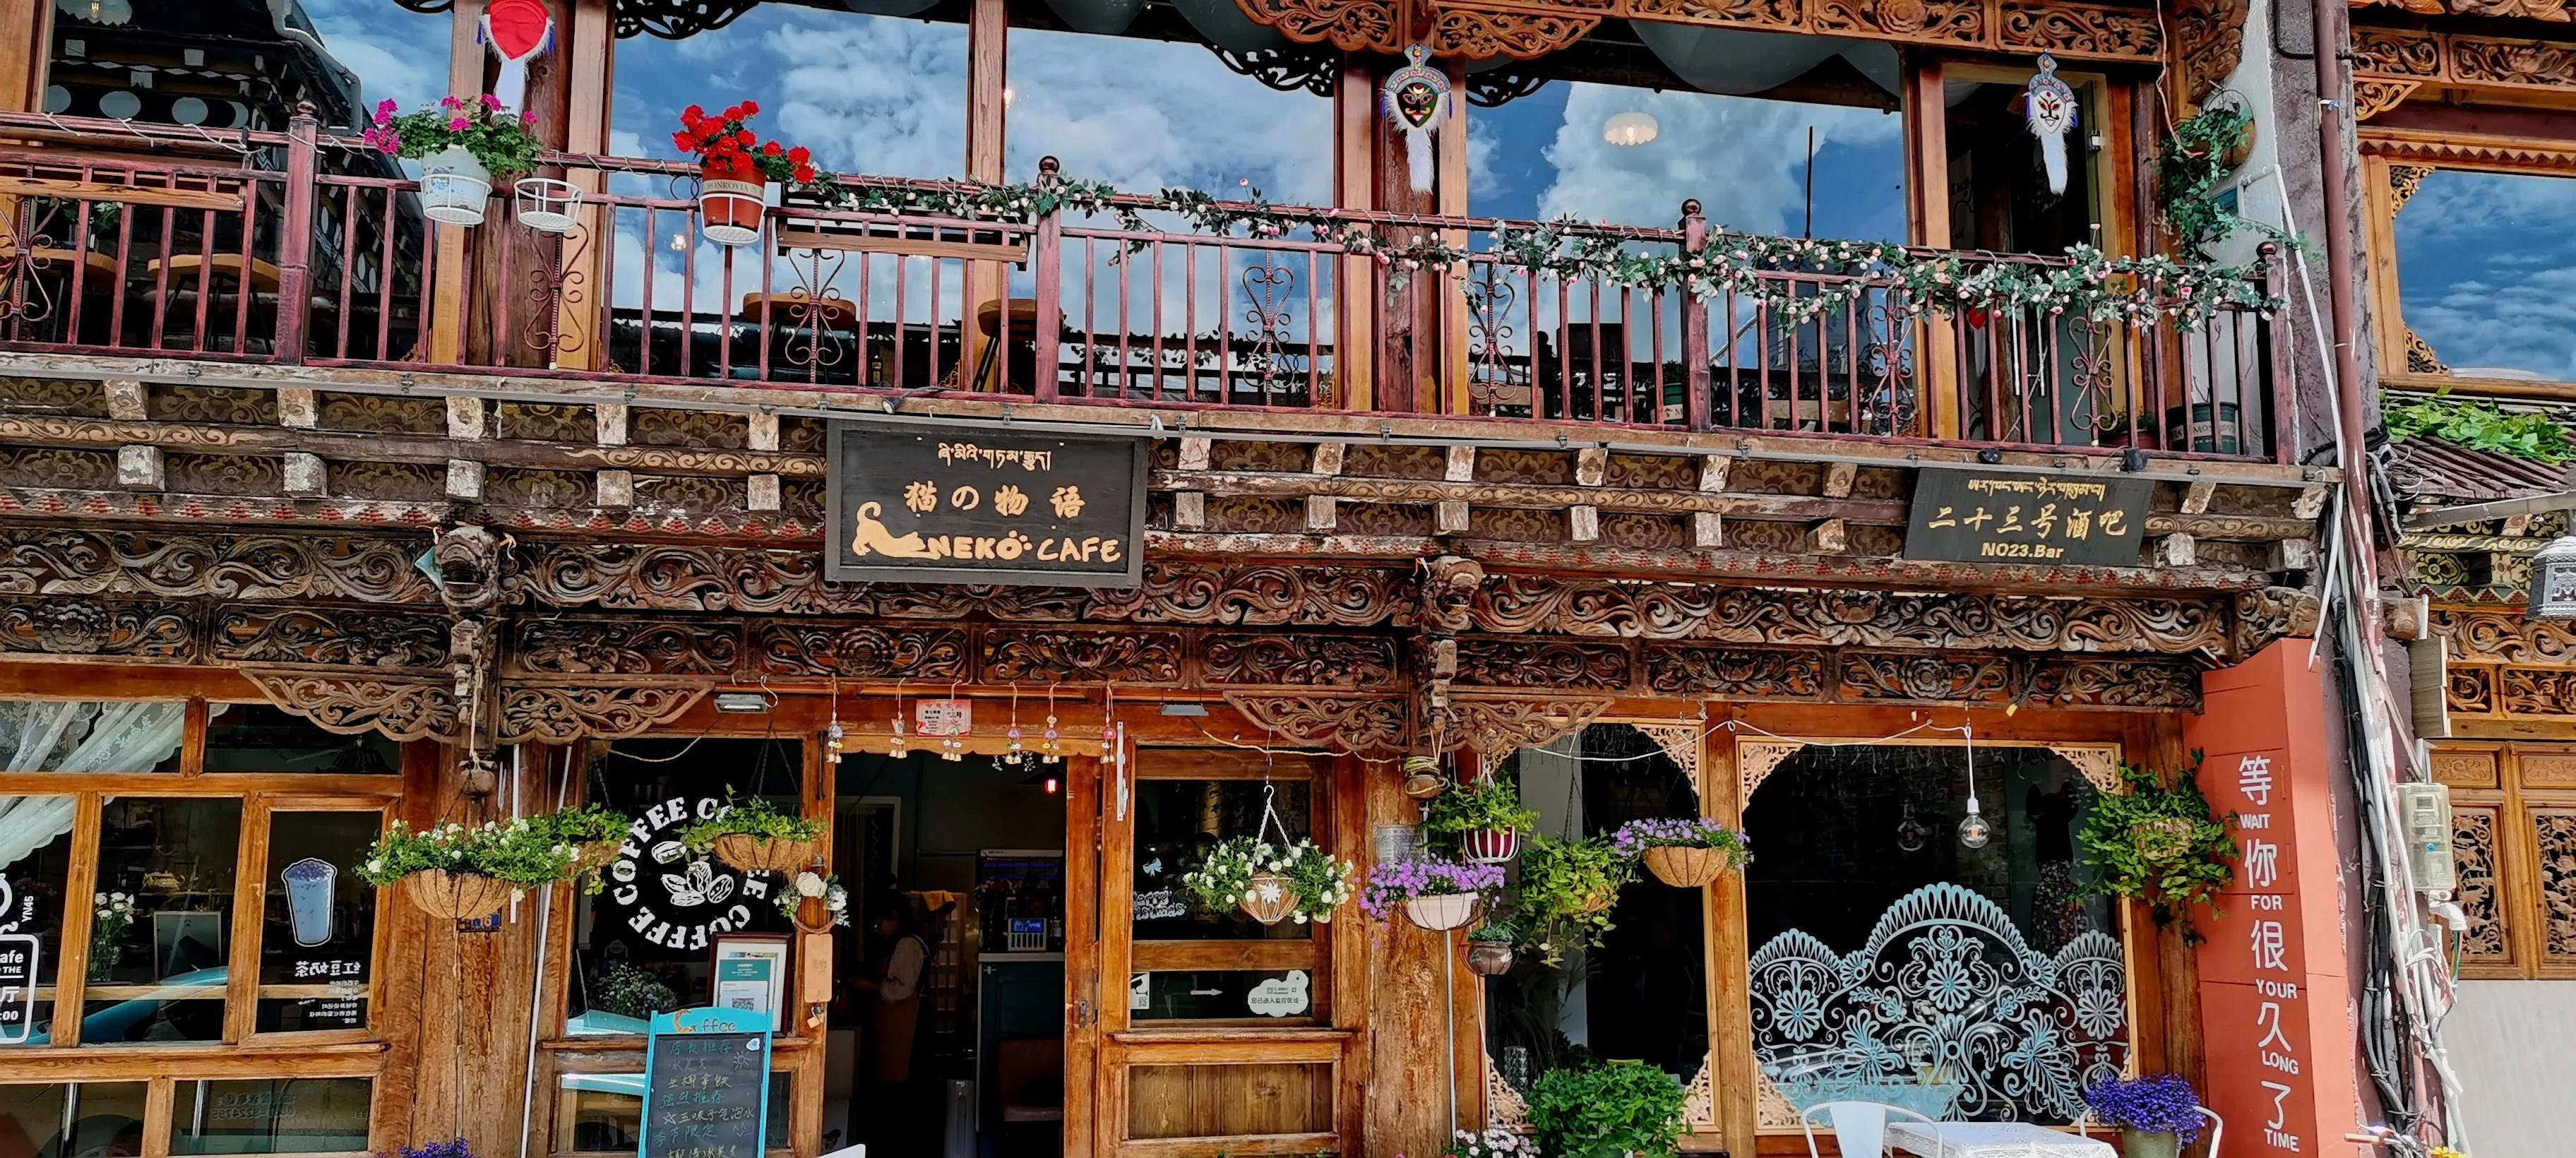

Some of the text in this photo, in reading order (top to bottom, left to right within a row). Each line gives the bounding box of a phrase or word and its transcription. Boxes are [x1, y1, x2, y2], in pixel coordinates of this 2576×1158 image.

[903, 479, 1086, 519] 猫の物语
[1928, 503, 2128, 541] 二十三号酒吧
[926, 532, 1121, 563] NEKO CAFE
[2238, 755, 2272, 805] 等
[2239, 813, 2271, 830] WAIT
[612, 796, 688, 905] COFFEE
[2244, 837, 2277, 889] 你
[21, 895, 34, 923] YN45
[2250, 894, 2283, 911] FOR
[2251, 919, 2289, 972] 很
[2, 965, 23, 974] THE
[2255, 978, 2298, 999] YOUR
[2257, 1001, 2292, 1052] 久
[2261, 1049, 2299, 1075] LONG
[2261, 1080, 2291, 1130] 了
[2263, 1128, 2300, 1153] TIME
